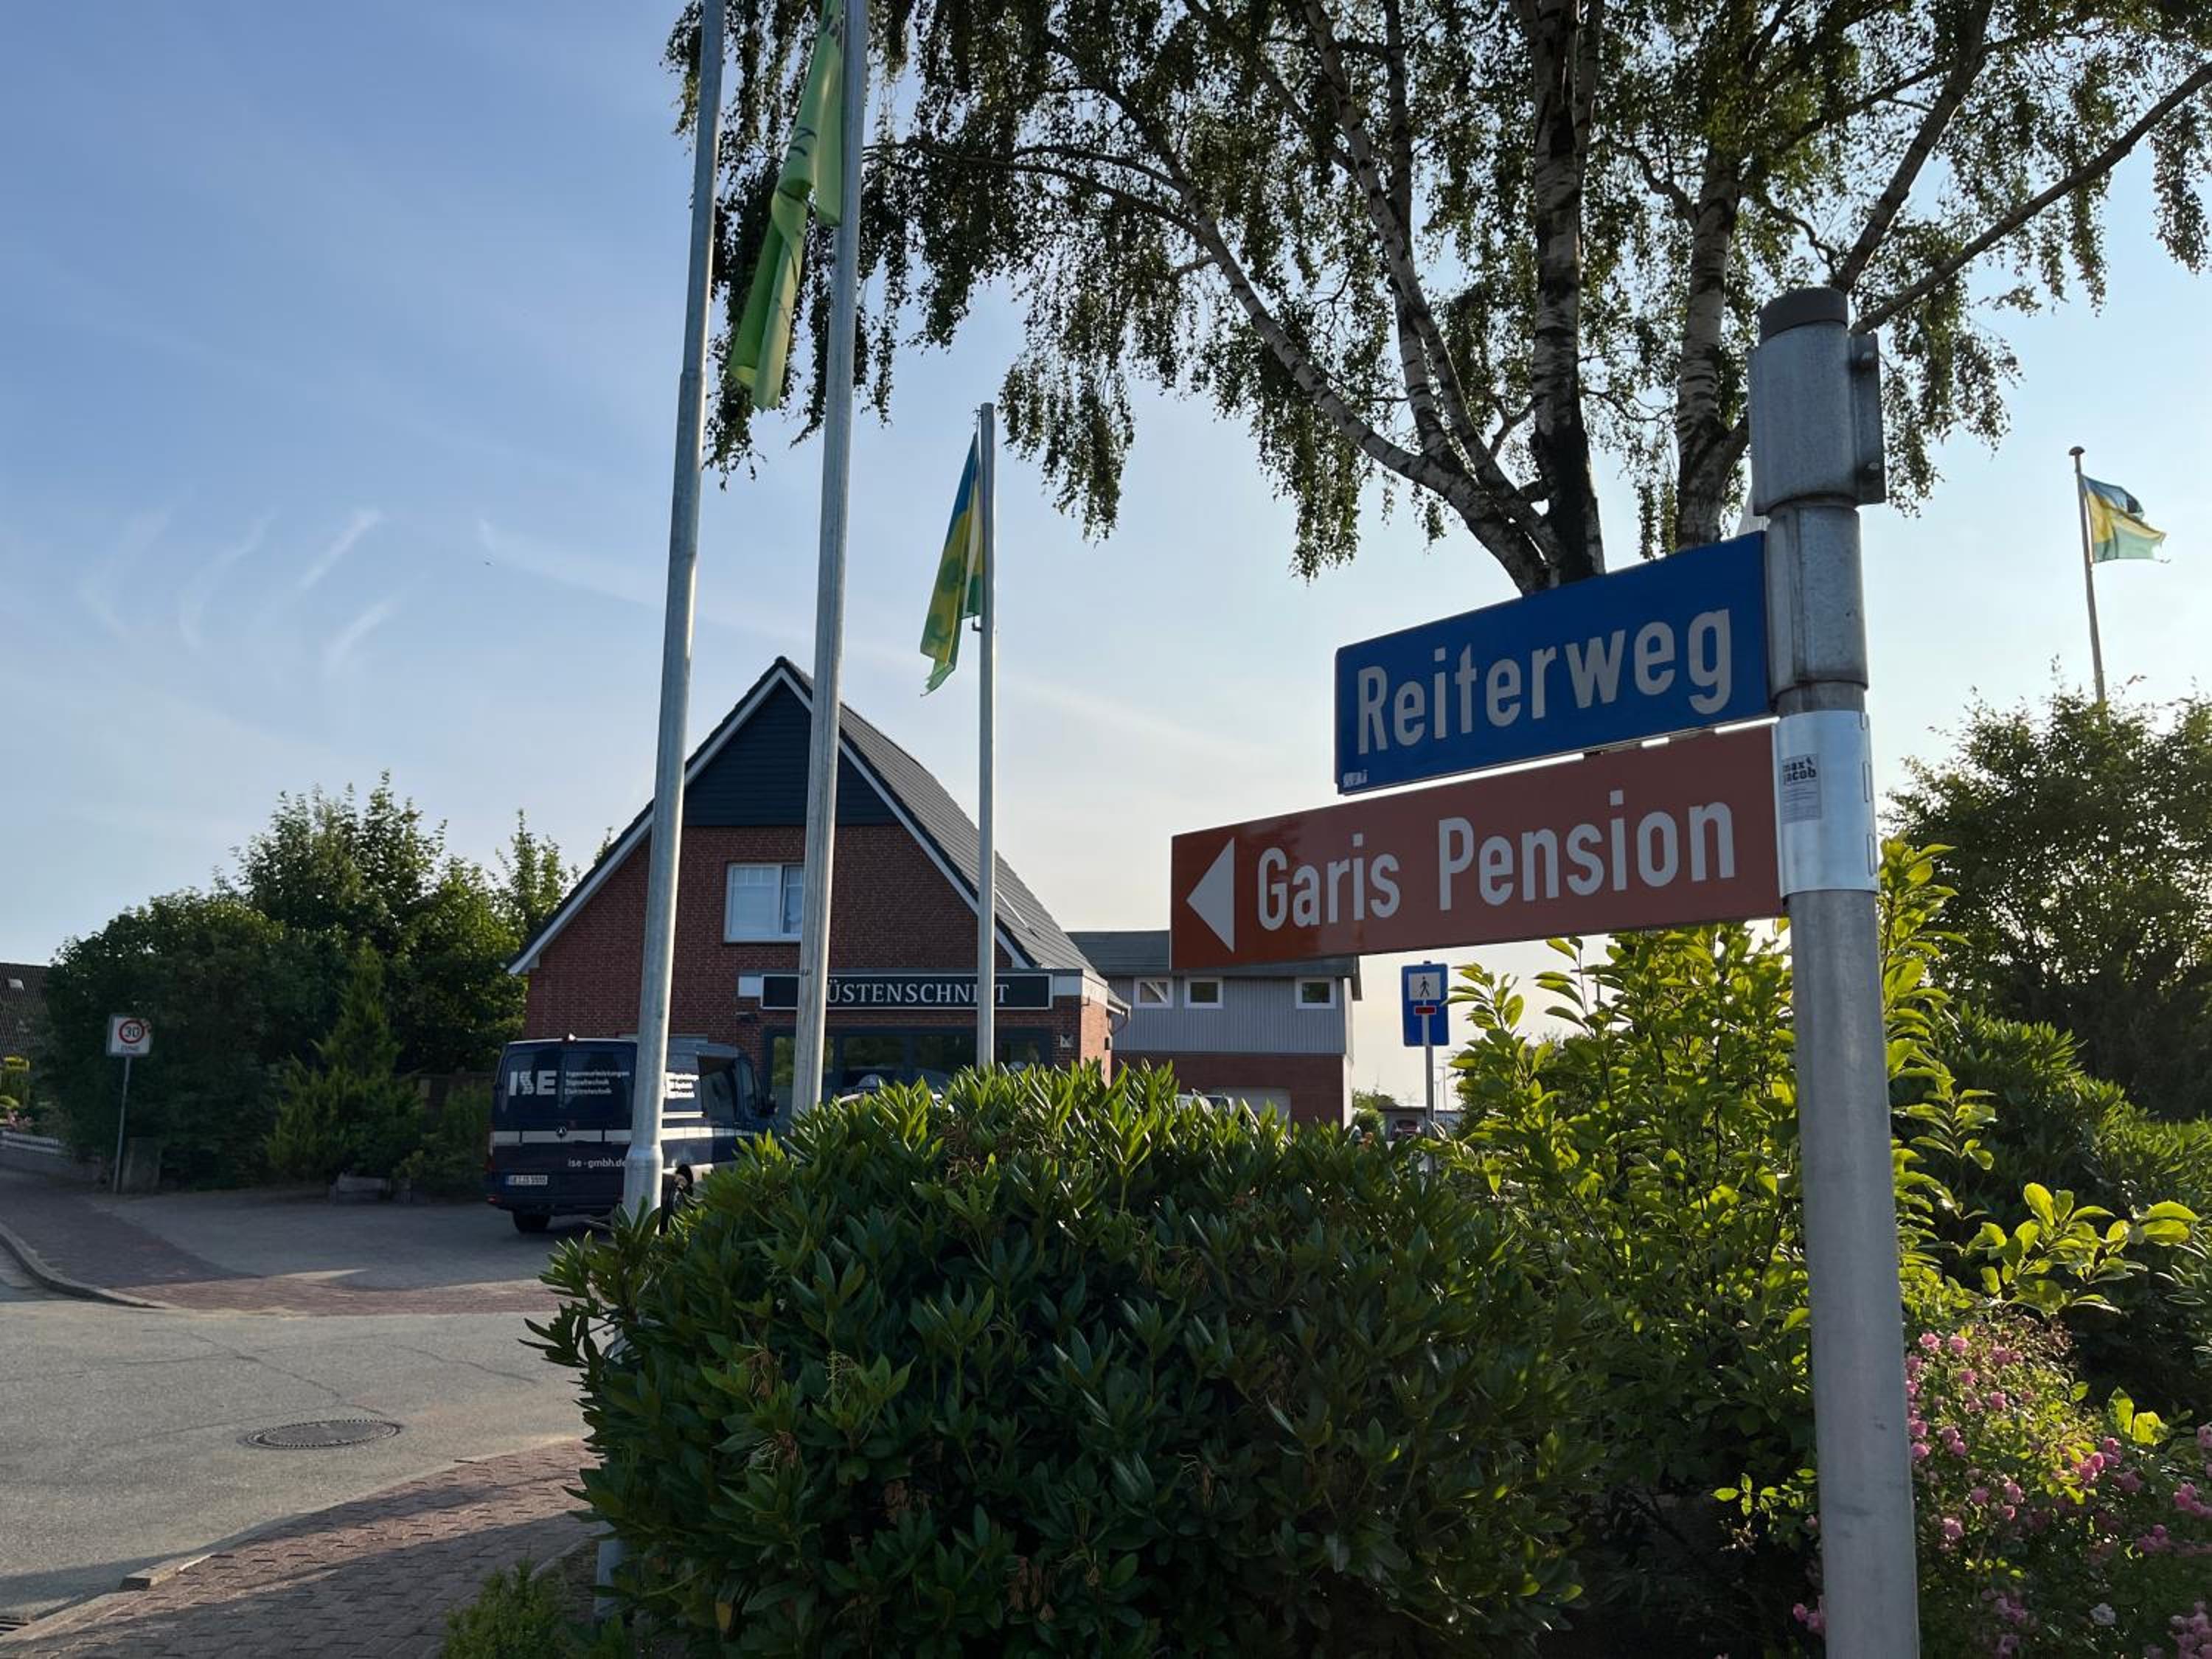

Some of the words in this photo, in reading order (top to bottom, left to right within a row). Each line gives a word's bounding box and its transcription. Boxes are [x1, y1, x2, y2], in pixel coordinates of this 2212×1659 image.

[1357, 608, 1732, 755] Reiterweg
[1257, 833, 1400, 932] Garis
[1439, 790, 1735, 911] Pension
[827, 978, 1009, 1003] ÜSTENSCHNIT
[125, 1026, 141, 1037] 30
[509, 1071, 557, 1096] ISE
